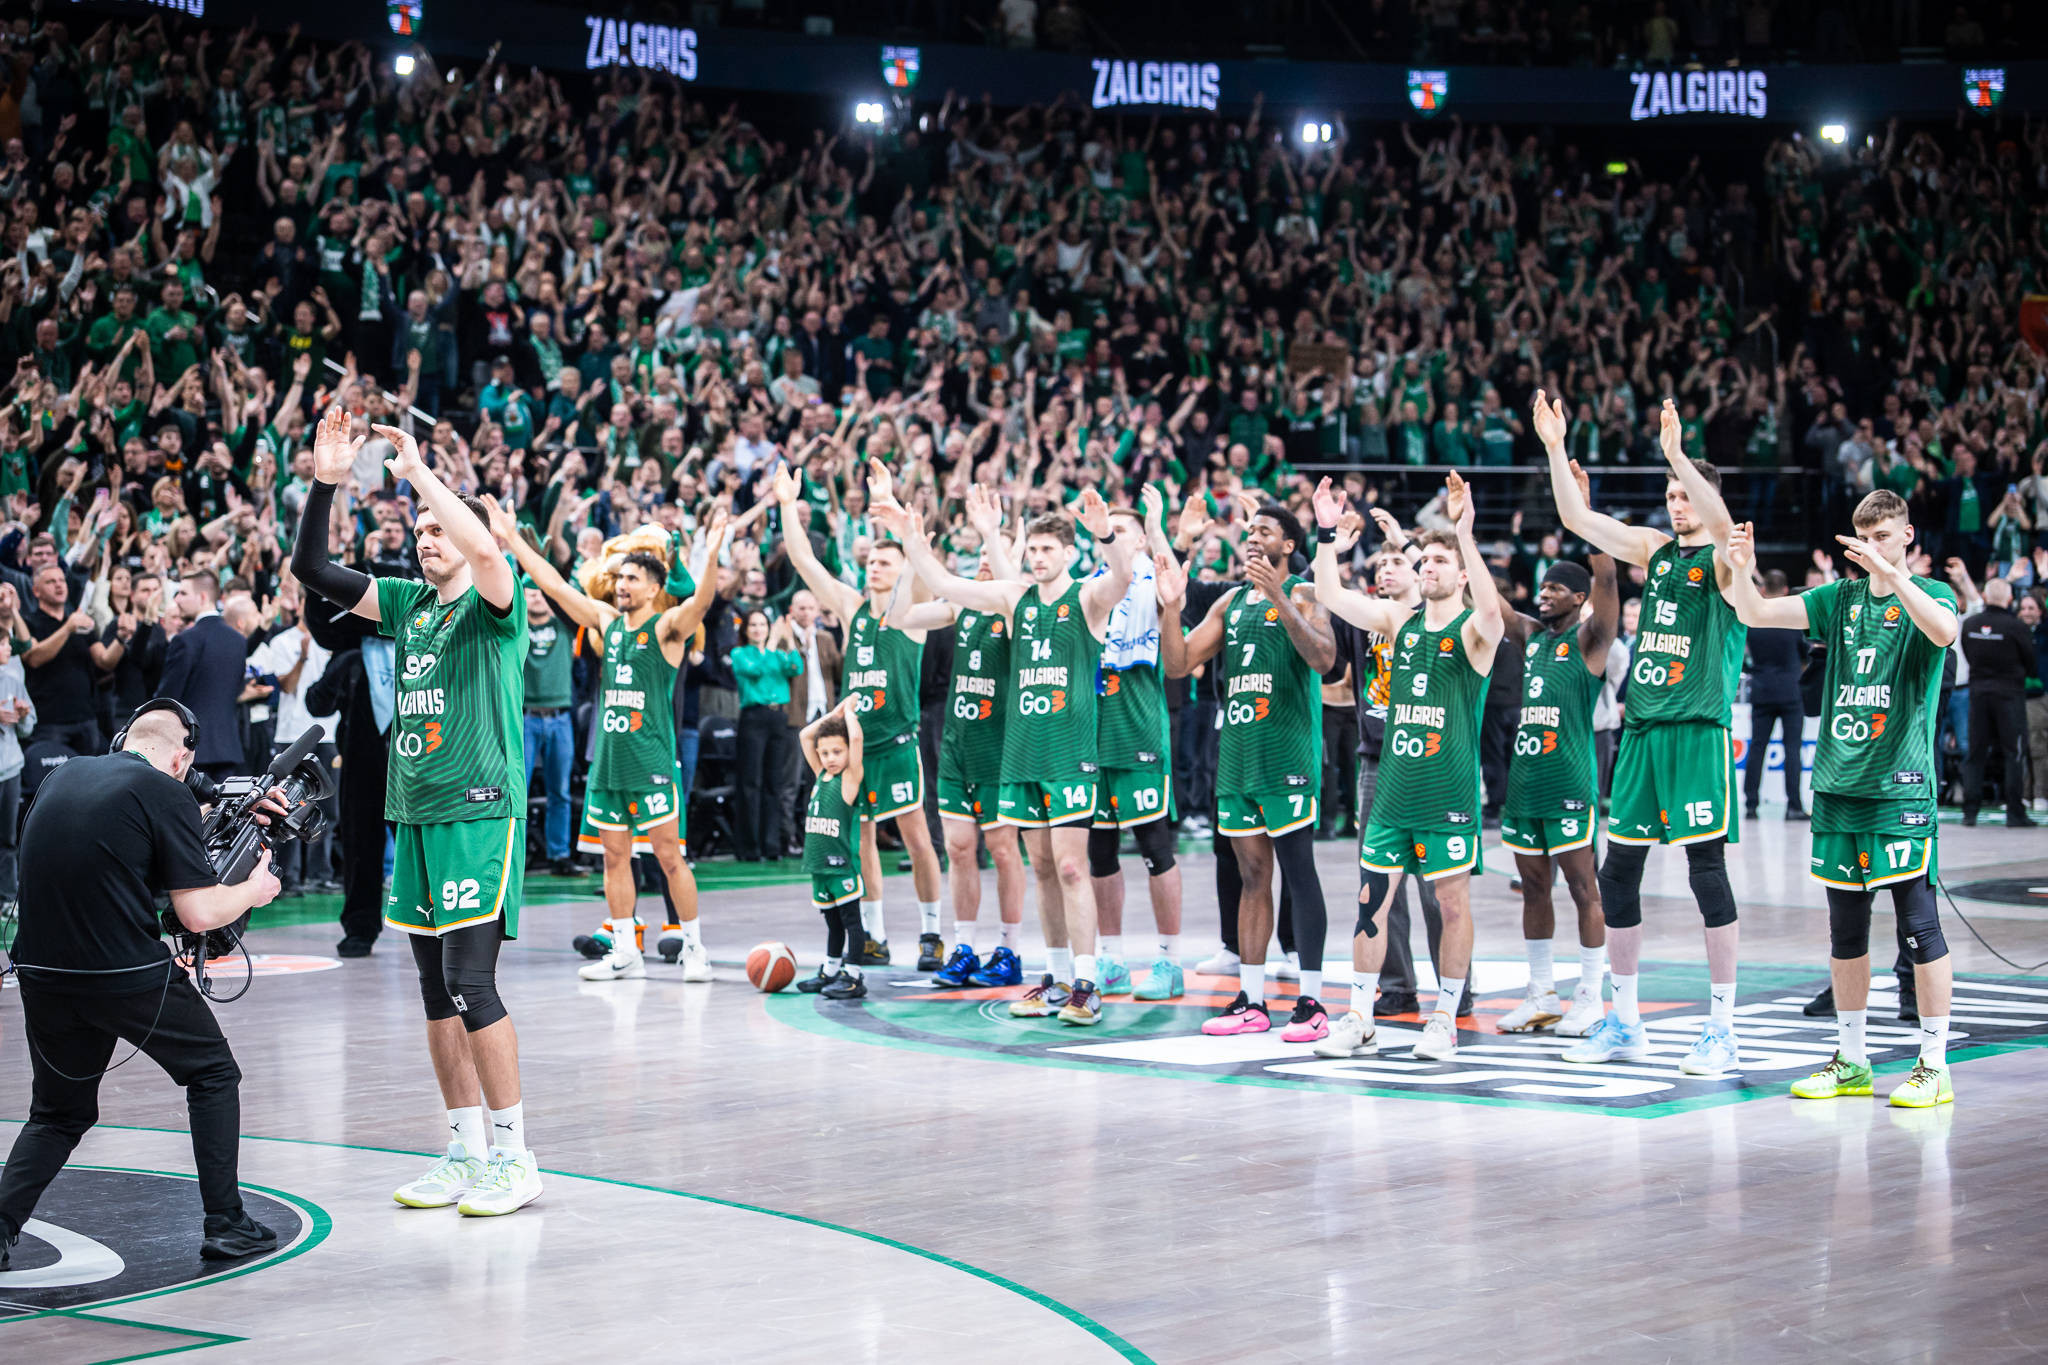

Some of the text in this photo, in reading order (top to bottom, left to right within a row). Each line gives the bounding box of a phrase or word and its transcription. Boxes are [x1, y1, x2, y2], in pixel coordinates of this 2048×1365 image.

[1092, 59, 1220, 111] ZALGIRIS
[1630, 70, 1767, 120] ZALGIRIS
[1655, 599, 1678, 626] 15
[1031, 638, 1052, 661] 14
[1241, 643, 1256, 667] 7
[1638, 631, 1691, 659] ZALGIRIS
[402, 653, 437, 680] 92
[968, 650, 981, 671] 8
[1634, 657, 1686, 686] Go3
[1857, 648, 1876, 674] 17
[615, 664, 633, 685] 12
[955, 675, 996, 697] ZALGIRIS
[1019, 667, 1067, 689] ZALGIRIS
[1228, 673, 1273, 698] ZALGIRIS
[1411, 673, 1428, 697] 9
[1528, 676, 1544, 698] 3
[954, 696, 993, 720] Go3
[1020, 690, 1066, 715] Go3
[1835, 684, 1890, 709] ZALGIRIS
[603, 710, 643, 733] Go3
[1227, 697, 1270, 725] Go3
[1394, 704, 1445, 729] ZALGIRIS
[1831, 712, 1887, 741] Go3
[1392, 729, 1442, 758] Go3
[1514, 731, 1558, 756] Go3
[645, 793, 669, 815] 12
[891, 781, 913, 803] 51
[1062, 785, 1087, 809] 14
[1133, 788, 1158, 811] 10
[1287, 794, 1304, 817] 7
[1685, 800, 1714, 827] 15
[1561, 818, 1578, 837] 3
[1446, 836, 1466, 861] 9
[1885, 840, 1911, 869] 17
[442, 879, 480, 911] 92
